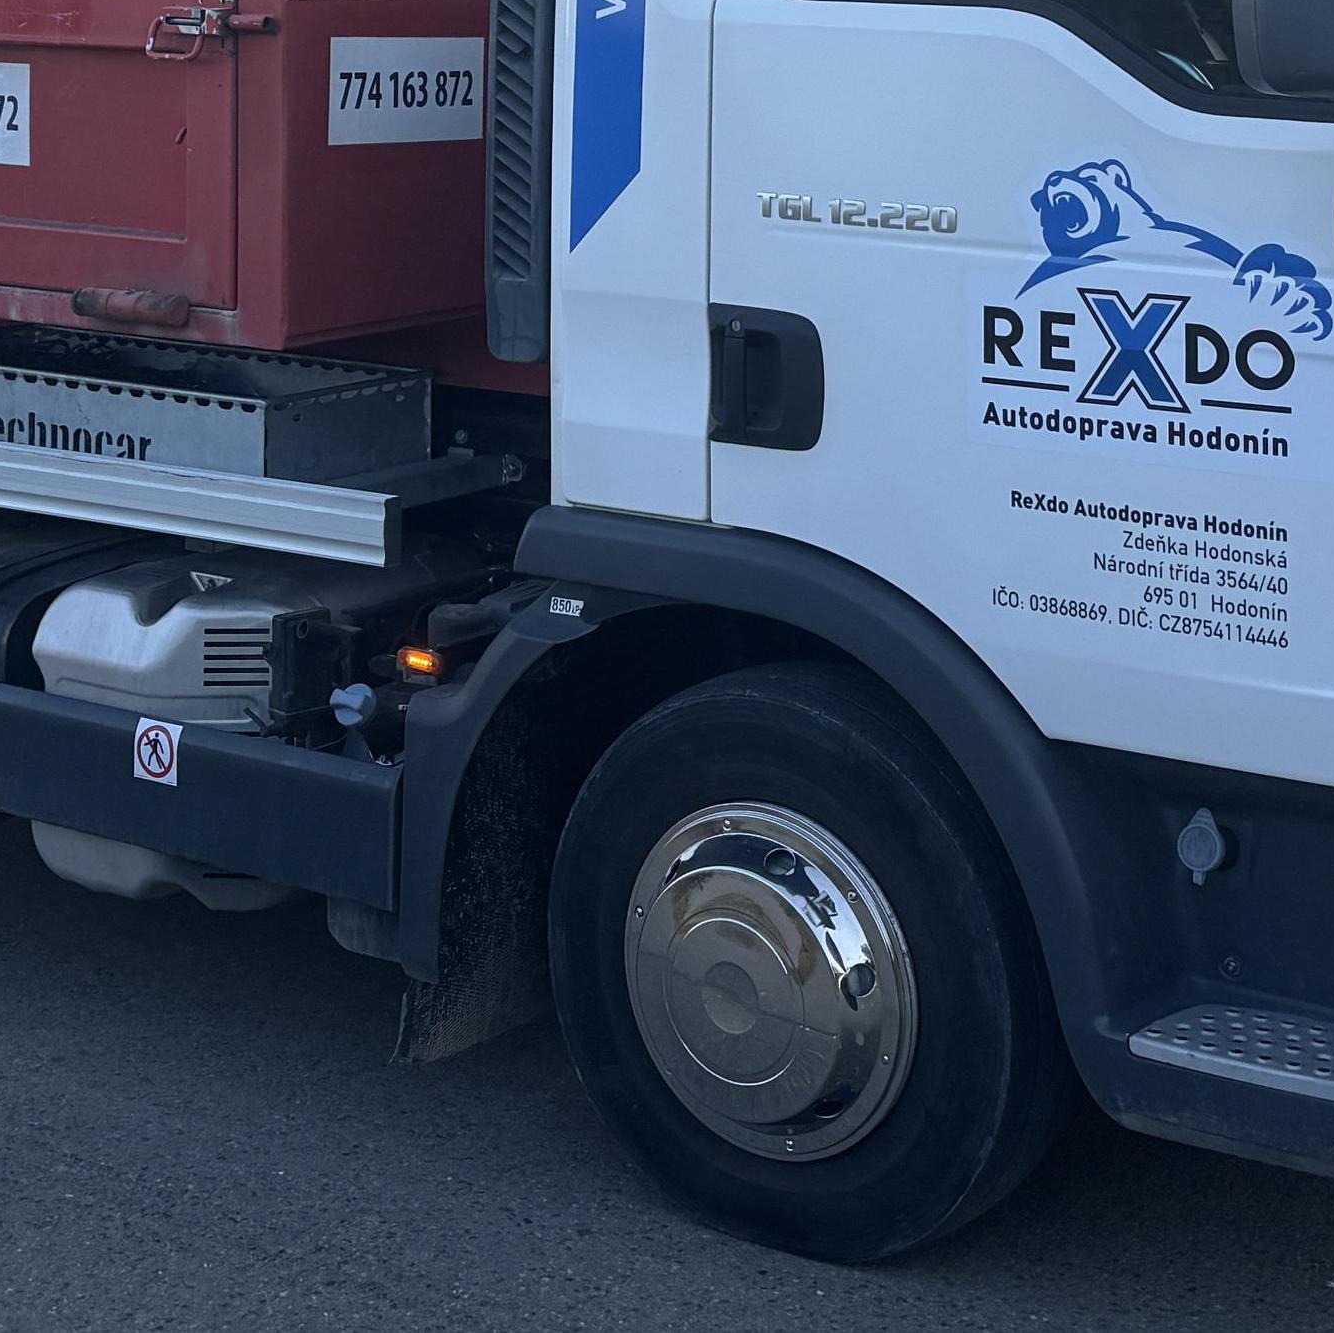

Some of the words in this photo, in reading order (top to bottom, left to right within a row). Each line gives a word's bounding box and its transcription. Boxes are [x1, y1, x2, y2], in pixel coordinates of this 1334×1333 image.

[339, 71, 383, 110] 774
[389, 70, 429, 109] 163
[434, 69, 474, 108] 872
[757, 192, 822, 223] TGL
[828, 198, 958, 234] 12.220
[982, 287, 1296, 414] REXDO
[983, 402, 1158, 444] Autodoprava
[1168, 421, 1289, 457] Hodonín
[1011, 490, 1068, 514] ReXdo
[1074, 499, 1198, 531] Autodoprava
[1204, 515, 1288, 542] Hodonín
[1123, 531, 1188, 556] Zdeňka
[1195, 540, 1288, 568] Hodonská
[1094, 552, 1163, 578] Národní
[1170, 564, 1210, 585] třída
[1217, 570, 1288, 595] 3564/40
[552, 598, 571, 613] 850
[993, 585, 1025, 610] IČO:
[1119, 607, 1153, 630] DIČ:
[1159, 614, 1289, 649] CZ8754114446
[1143, 585, 1173, 606] 695
[1179, 590, 1198, 610] 01
[1211, 594, 1288, 622] Hodonín
